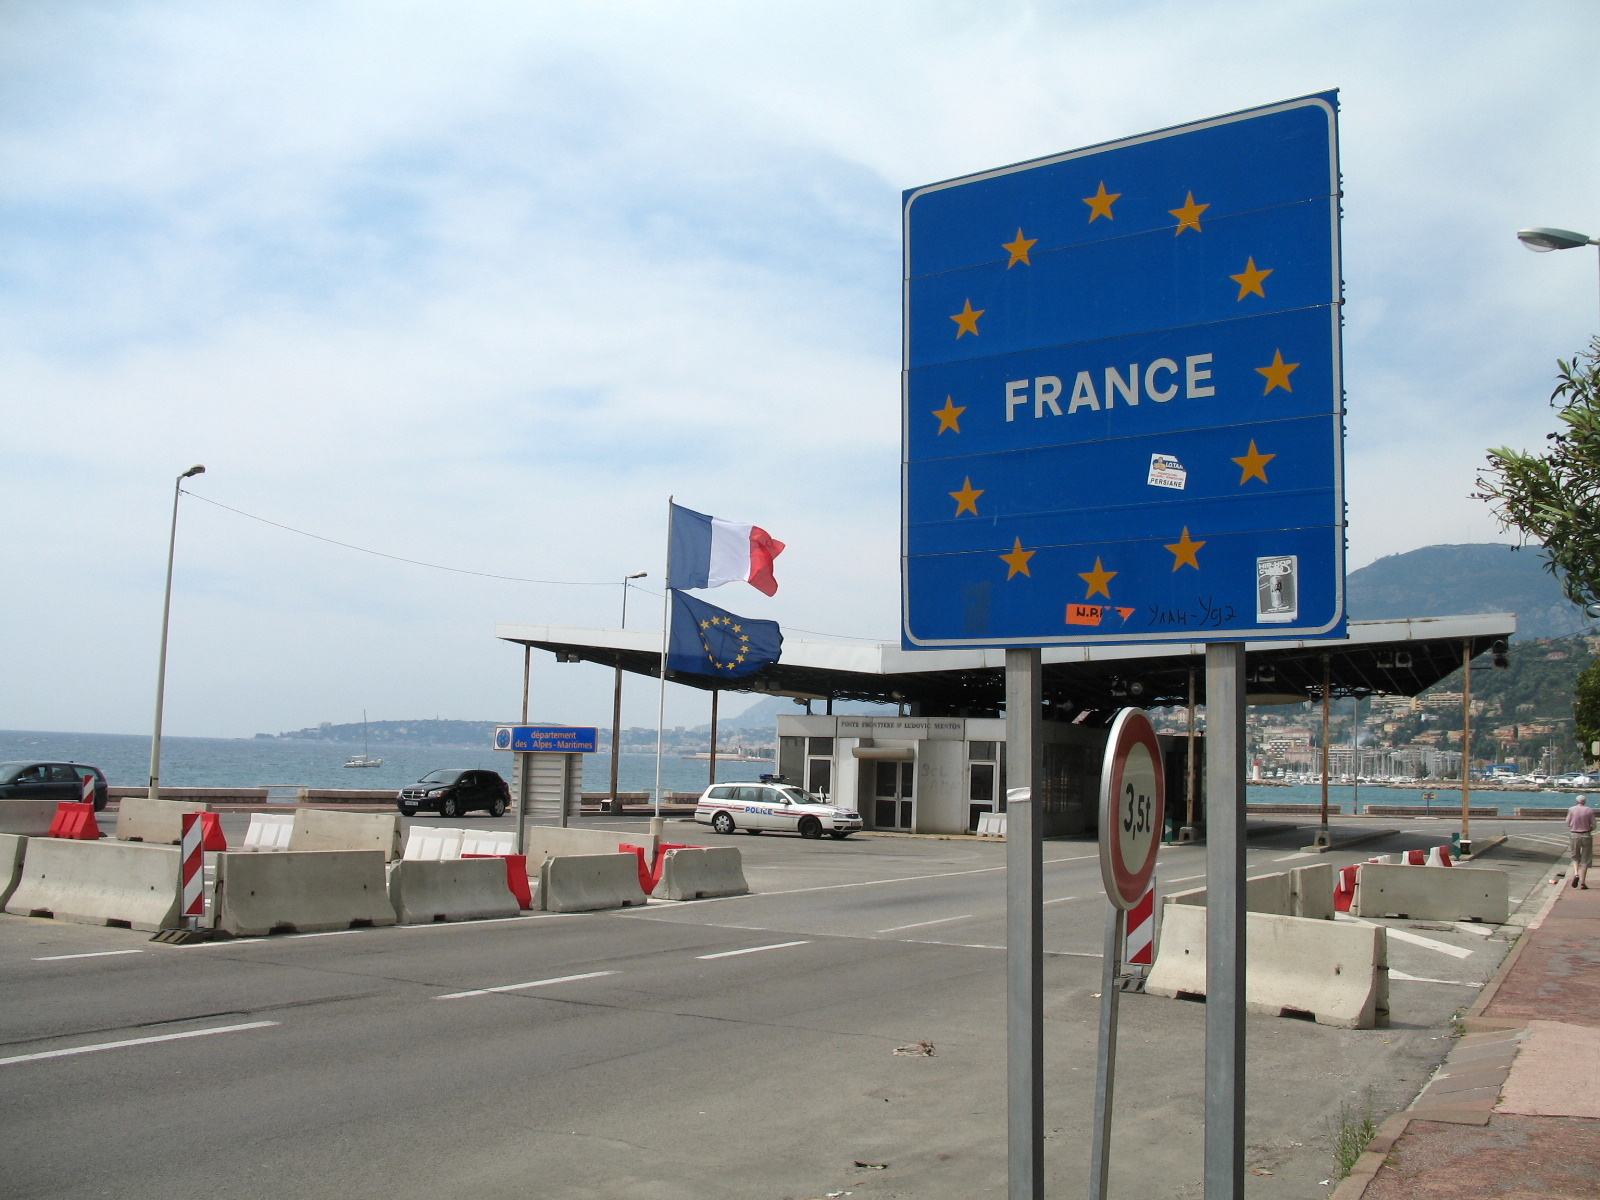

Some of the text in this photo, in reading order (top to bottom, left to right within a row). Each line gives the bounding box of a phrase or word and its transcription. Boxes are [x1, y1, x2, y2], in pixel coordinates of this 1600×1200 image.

[1005, 352, 1215, 422] FRANCE
[1150, 478, 1183, 487] PERSIANE
[531, 730, 577, 740] département
[745, 806, 773, 816] POLICE
[1123, 782, 1151, 841] 3,5t
